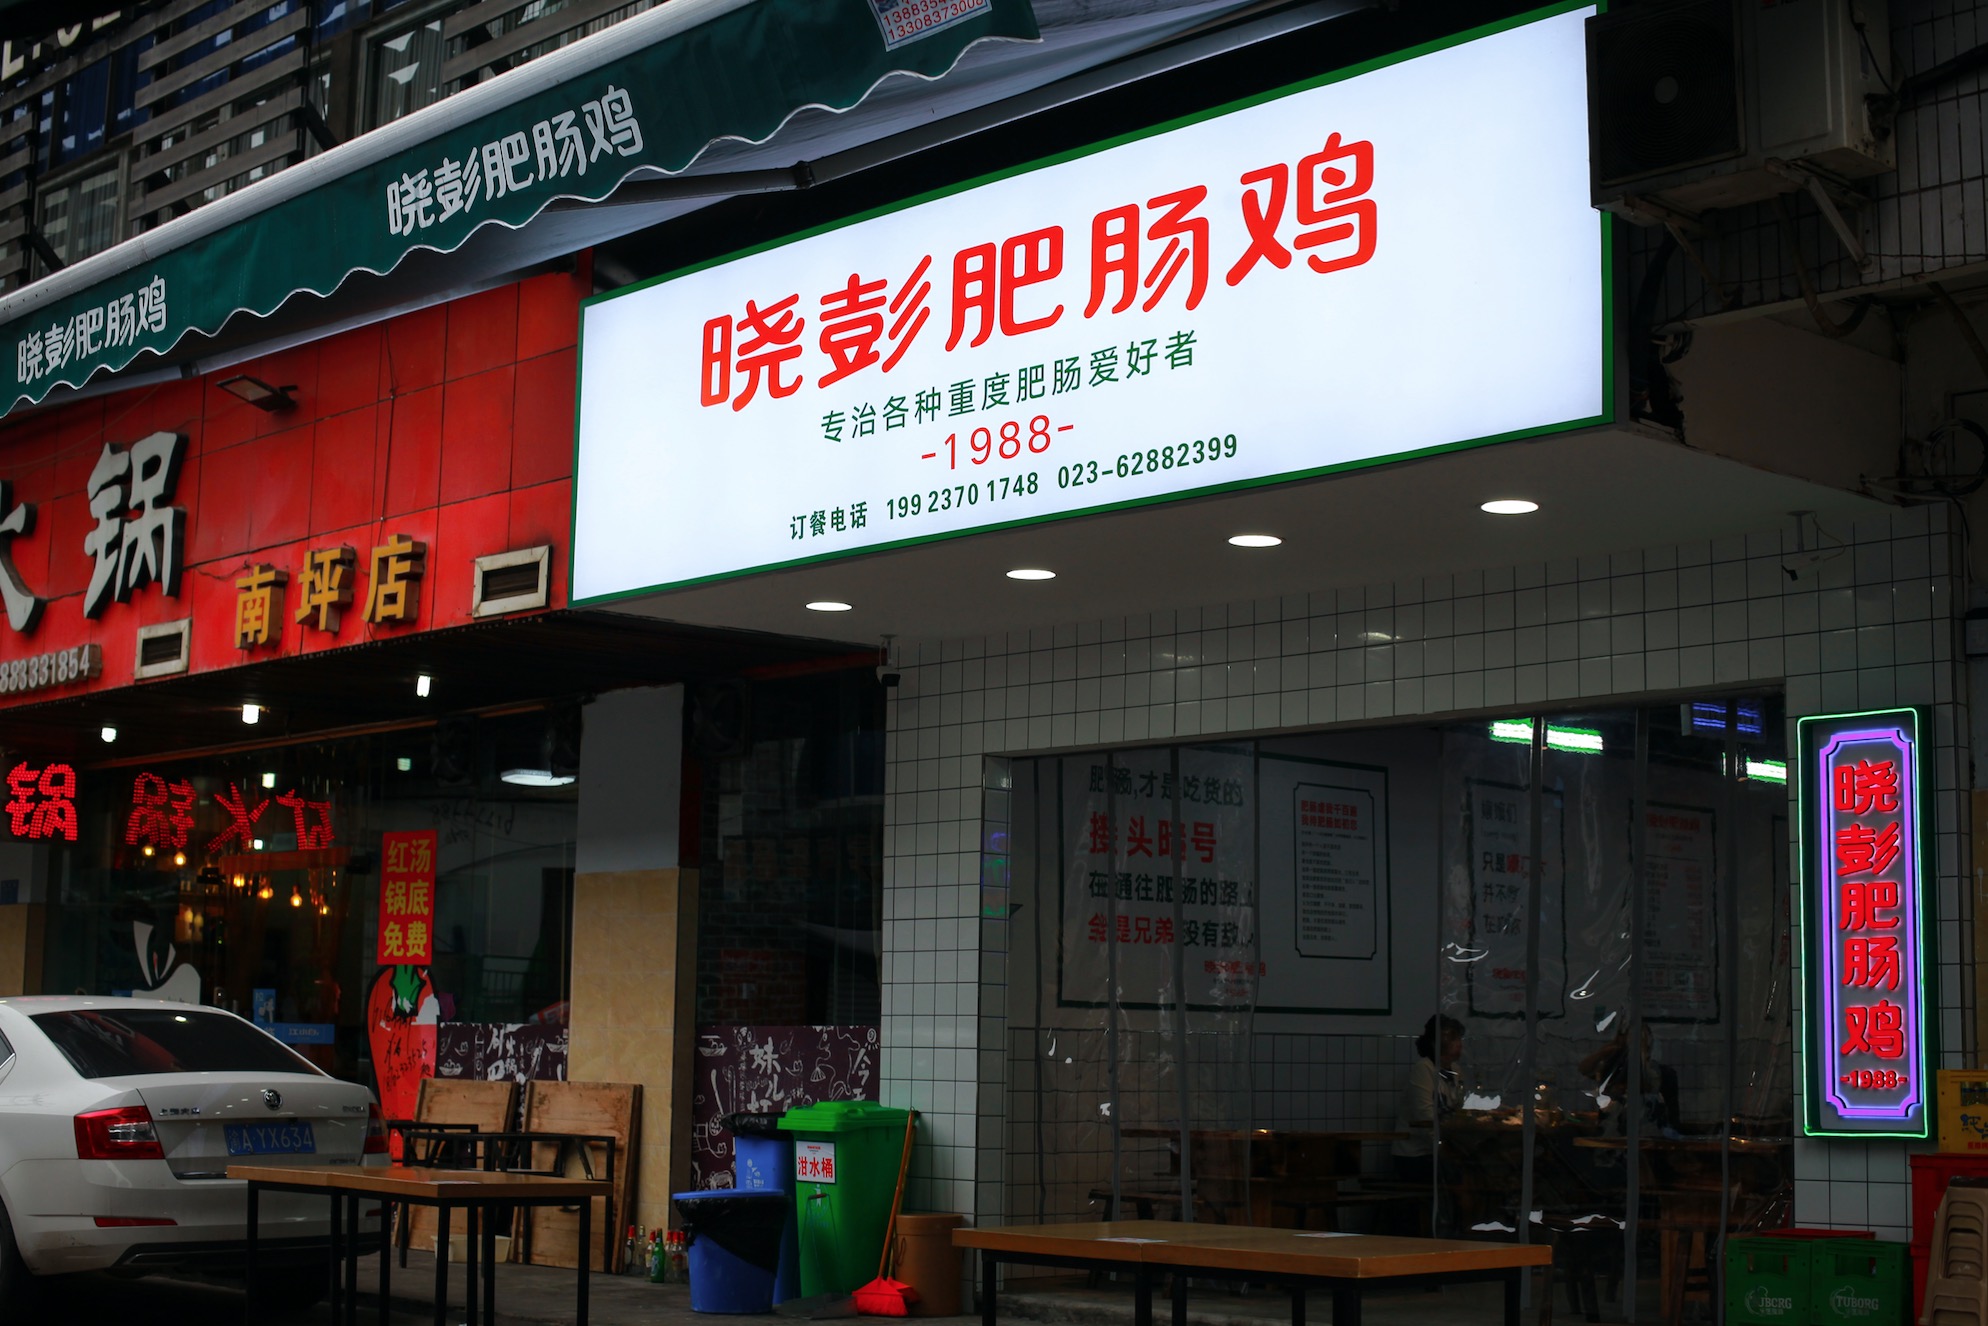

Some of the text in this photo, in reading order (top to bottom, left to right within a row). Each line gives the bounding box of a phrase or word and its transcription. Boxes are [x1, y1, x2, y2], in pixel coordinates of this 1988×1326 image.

[386, 83, 646, 238] 晓彭肥肠鸡
[701, 132, 1378, 412] 晓彭肥肠鸡
[16, 274, 168, 386] 晓彭肥肠鸡
[821, 329, 1197, 443] 专治各种重度肥肠爱好者
[921, 414, 1075, 470] -1988-
[790, 501, 868, 540] 订餐电话
[1057, 433, 1237, 489] 023-62882399
[235, 534, 420, 650] 南坪店
[5, 761, 79, 842] 锅
[386, 838, 432, 873] 红汤
[384, 878, 430, 917] 锅底
[1833, 759, 1904, 1059] 晓彭肥肠鸡
[383, 920, 428, 958] 免费
[1839, 1069, 1908, 1091] -1988-
[797, 1156, 833, 1179] 泔水桶
[1836, 1295, 1879, 1311] TUBORG
